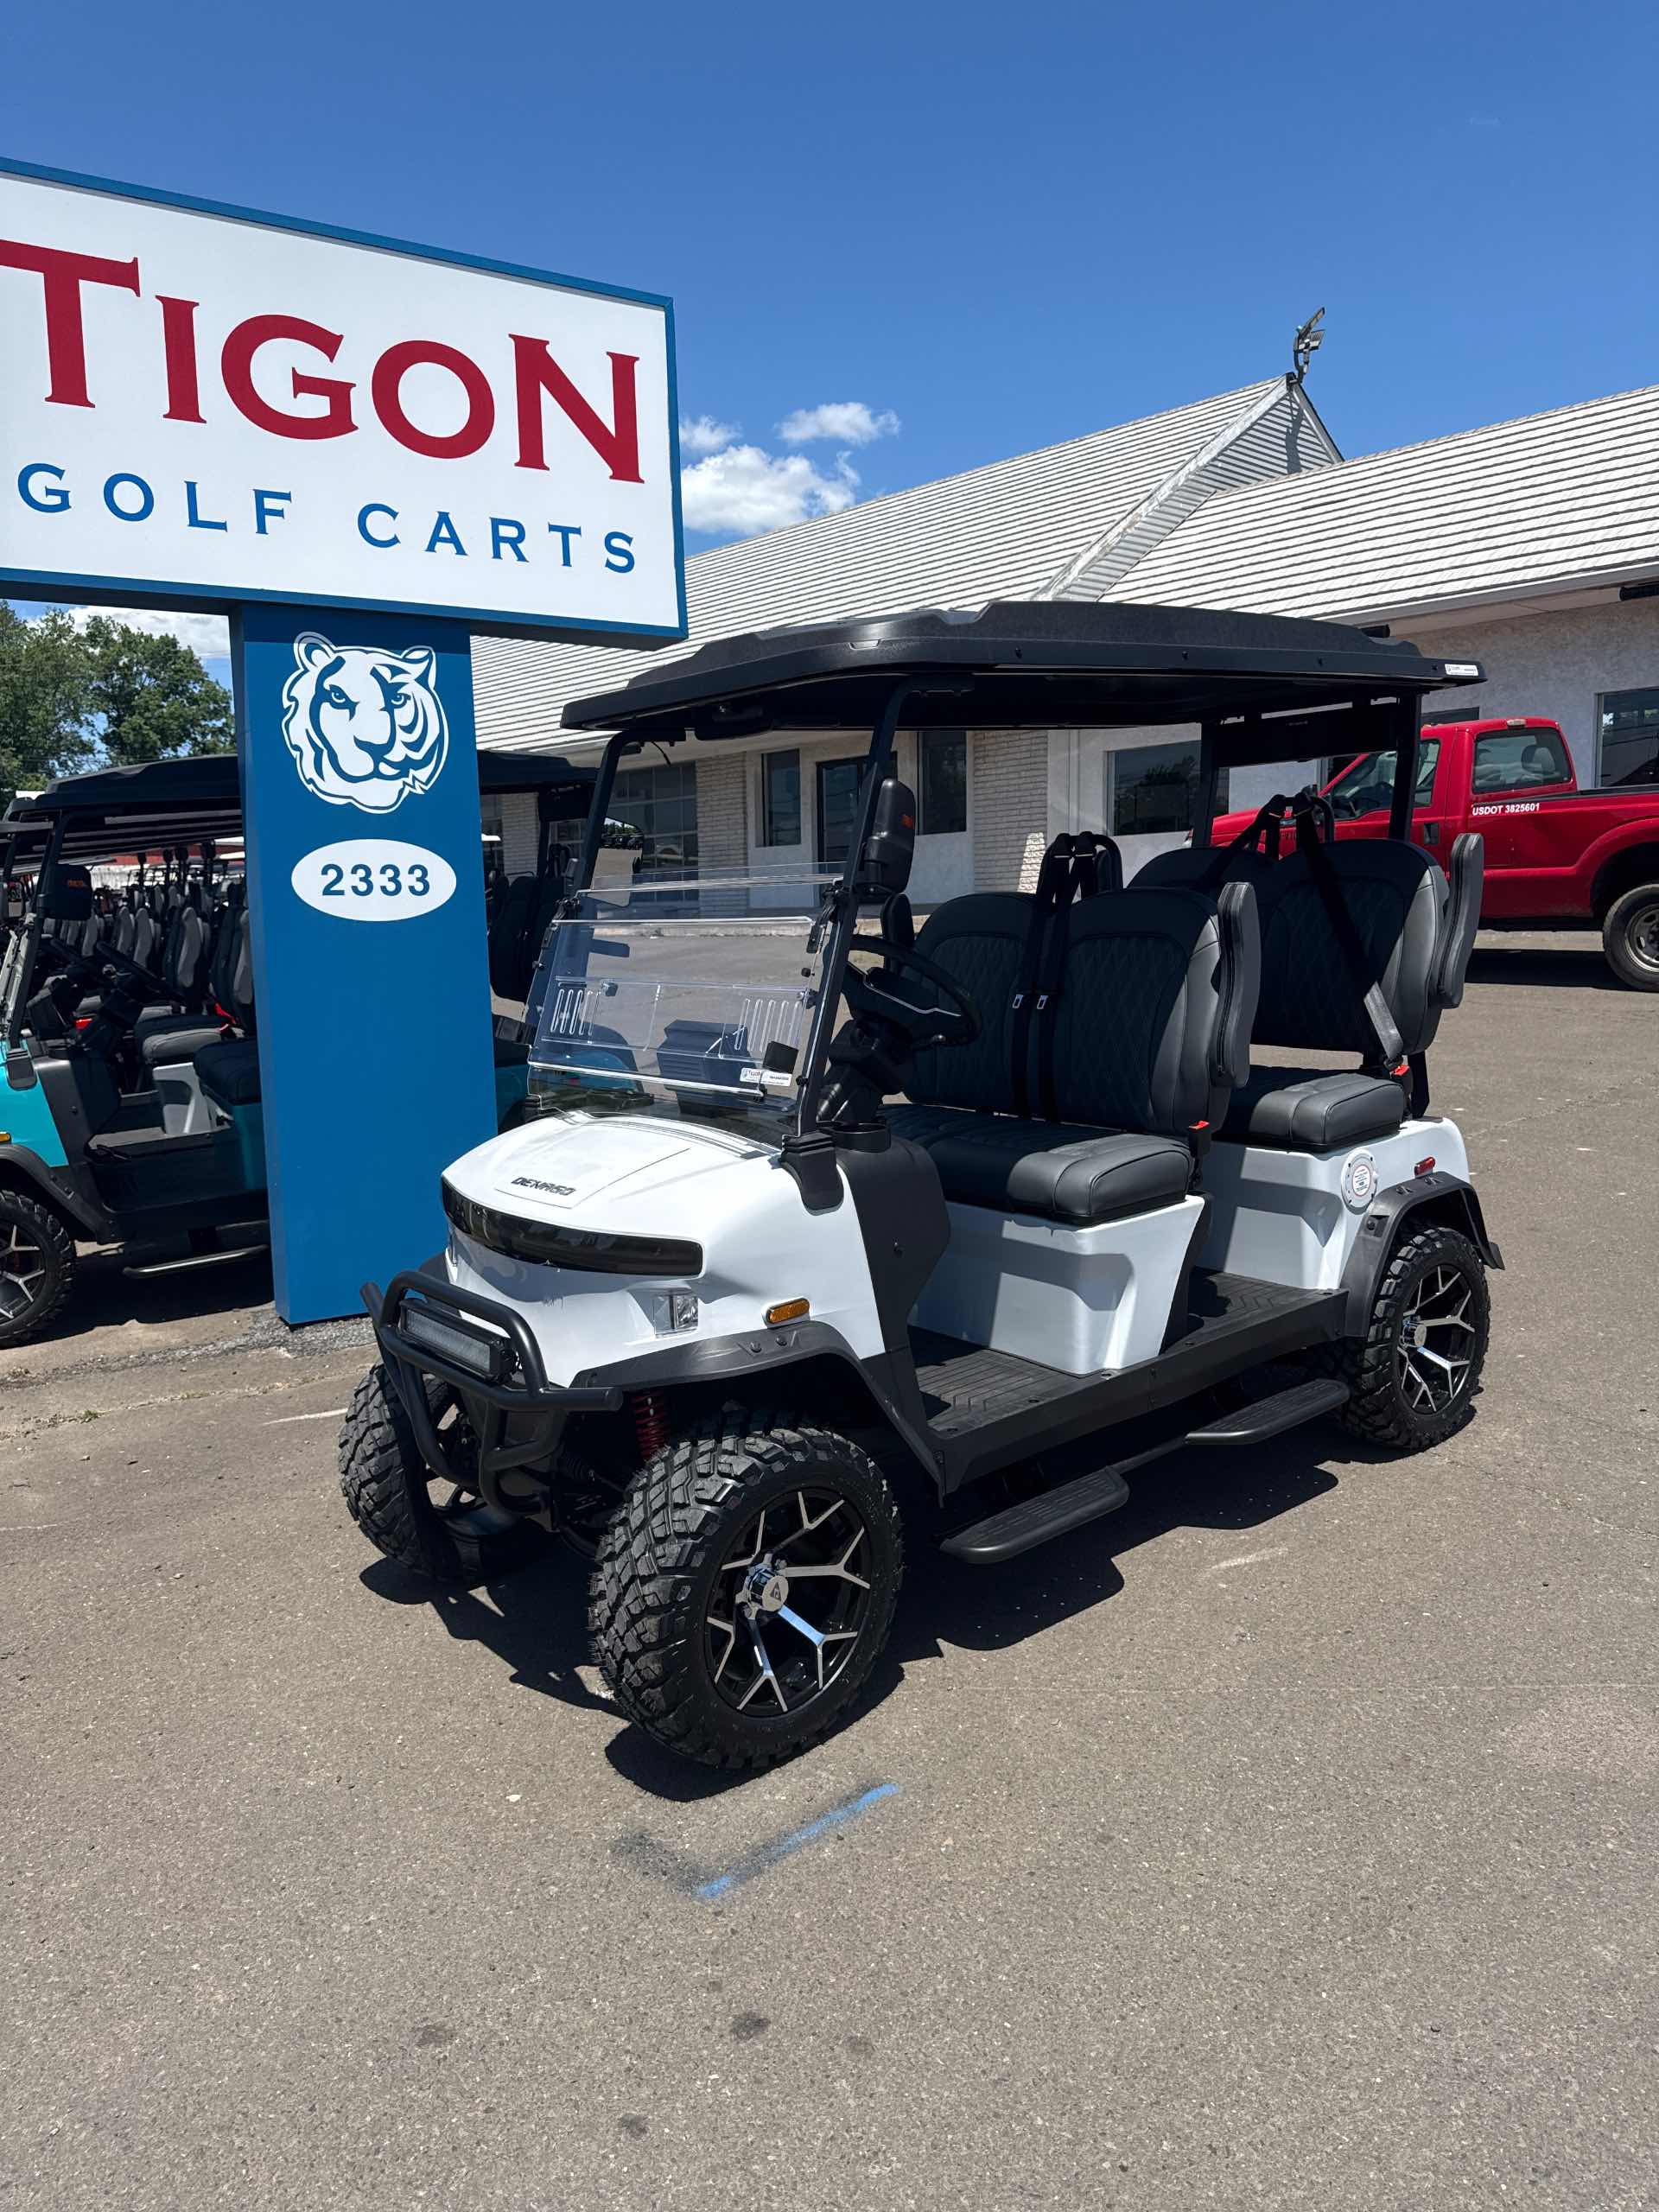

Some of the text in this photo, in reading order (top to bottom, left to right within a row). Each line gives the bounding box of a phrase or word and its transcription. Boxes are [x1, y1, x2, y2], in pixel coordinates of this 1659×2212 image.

[0, 238, 645, 484] TIGON
[17, 462, 636, 573] GOLF CARTS
[1471, 803, 1540, 816] USDOT 3825601
[321, 865, 429, 897] 2333
[511, 1177, 576, 1196] DENAGO
